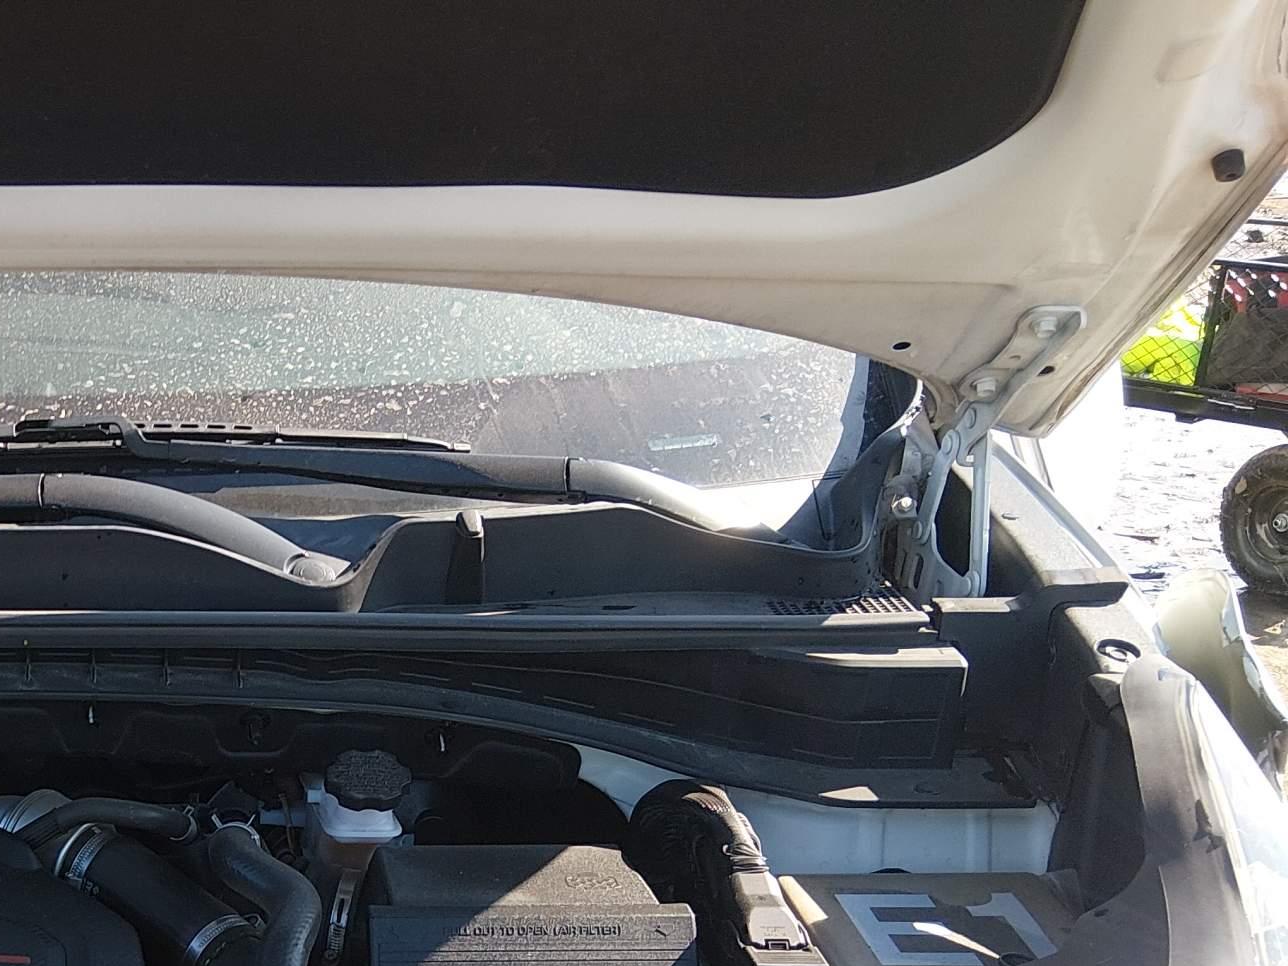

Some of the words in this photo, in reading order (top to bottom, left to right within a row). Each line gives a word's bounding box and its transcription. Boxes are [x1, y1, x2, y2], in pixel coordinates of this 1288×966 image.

[473, 925, 495, 937] OUT
[499, 925, 515, 937] TO
[517, 925, 549, 937] OPEN
[833, 891, 1058, 966] E1
